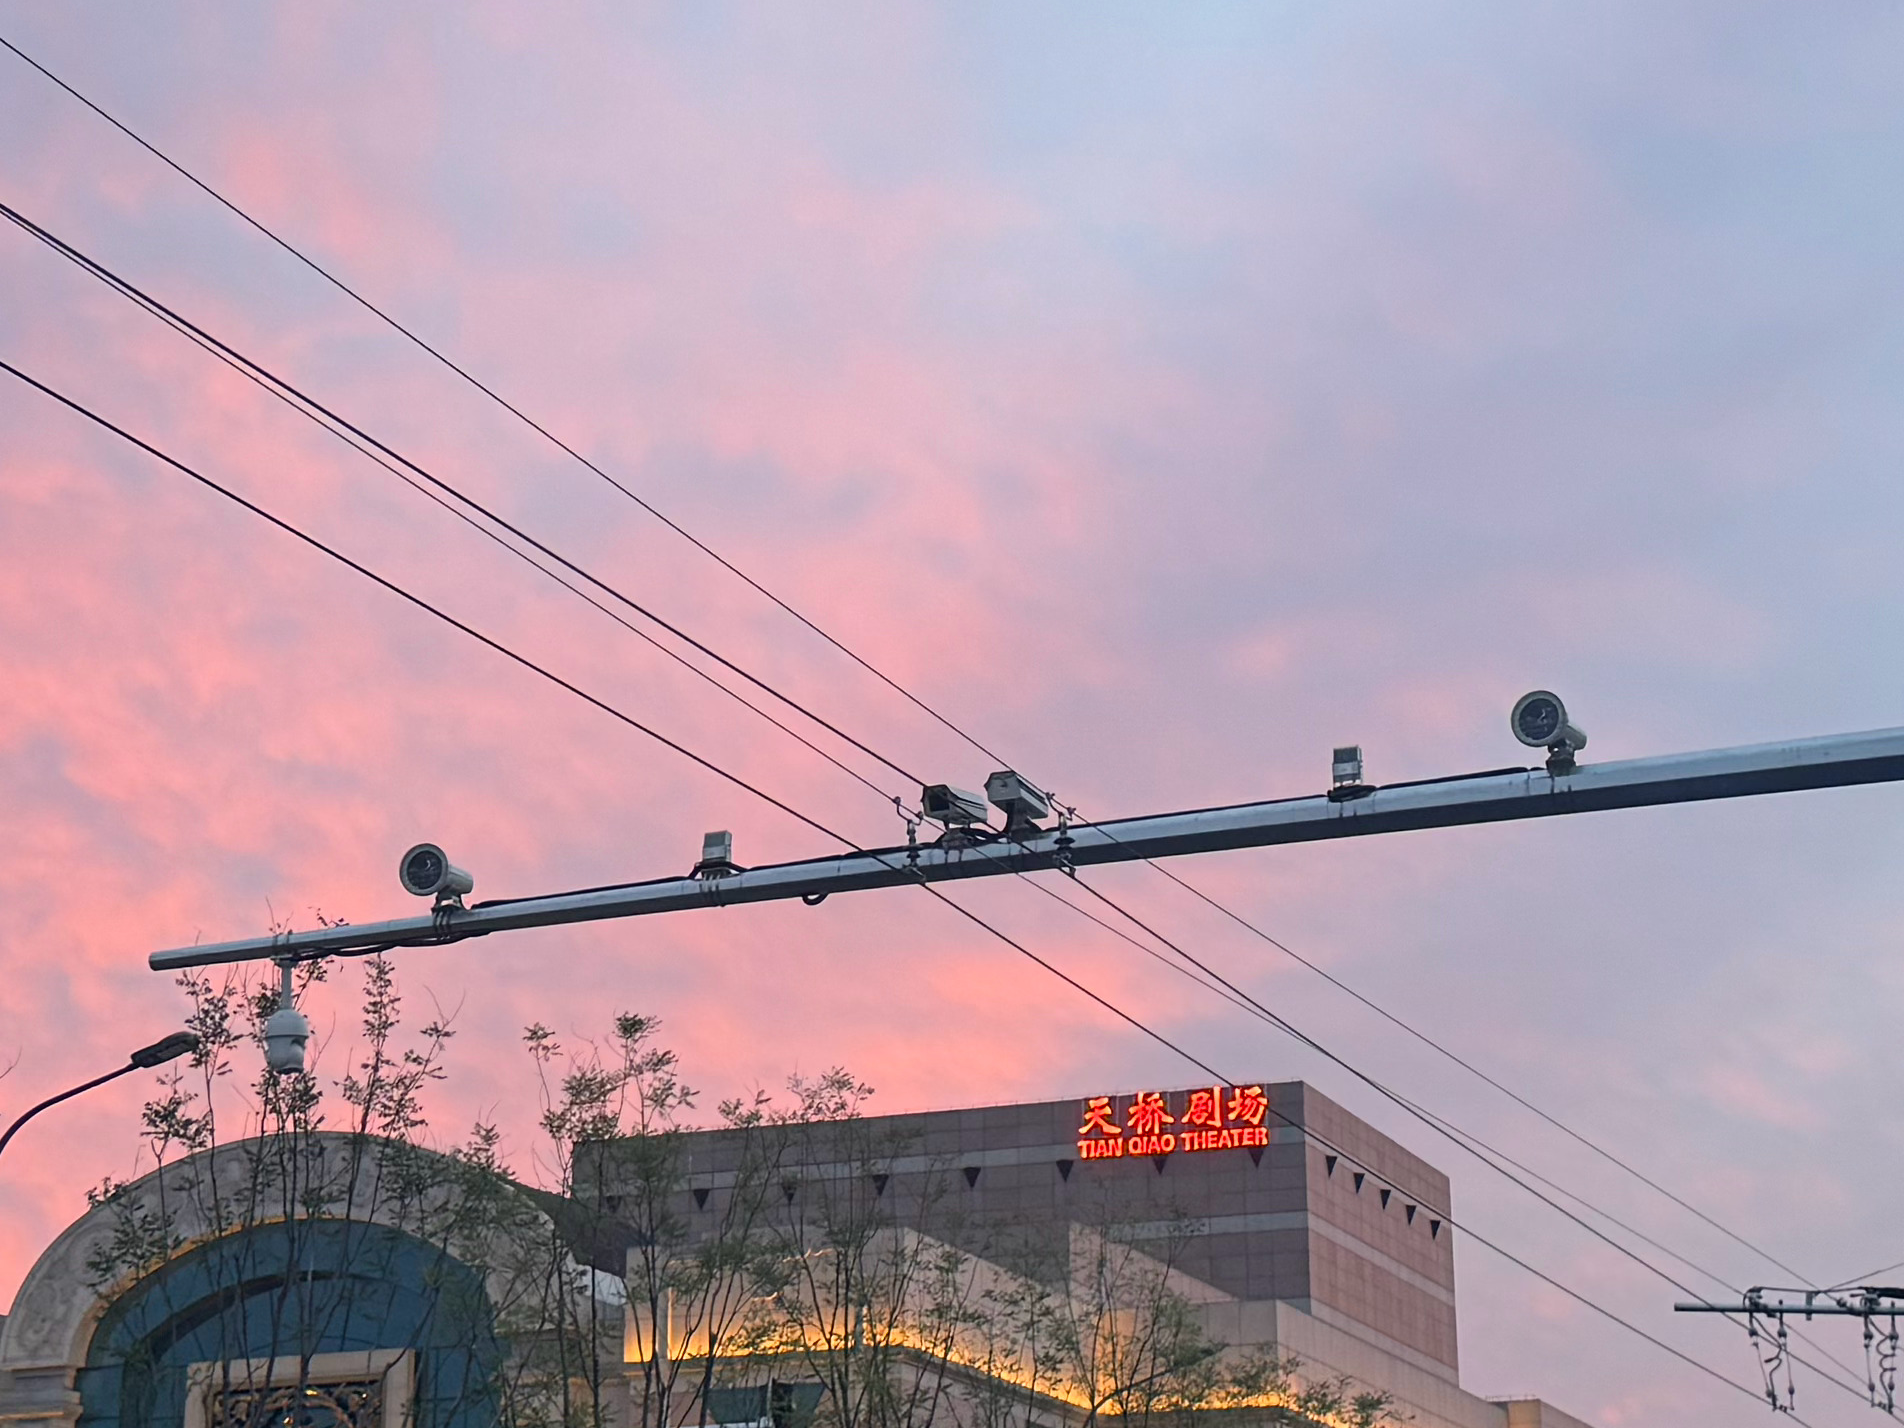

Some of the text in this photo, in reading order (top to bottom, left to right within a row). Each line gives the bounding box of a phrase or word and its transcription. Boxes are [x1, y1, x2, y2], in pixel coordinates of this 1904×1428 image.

[1078, 1085, 1269, 1135] 天桥剧场
[1077, 1127, 1268, 1159] TIAN QIAO THEATER
